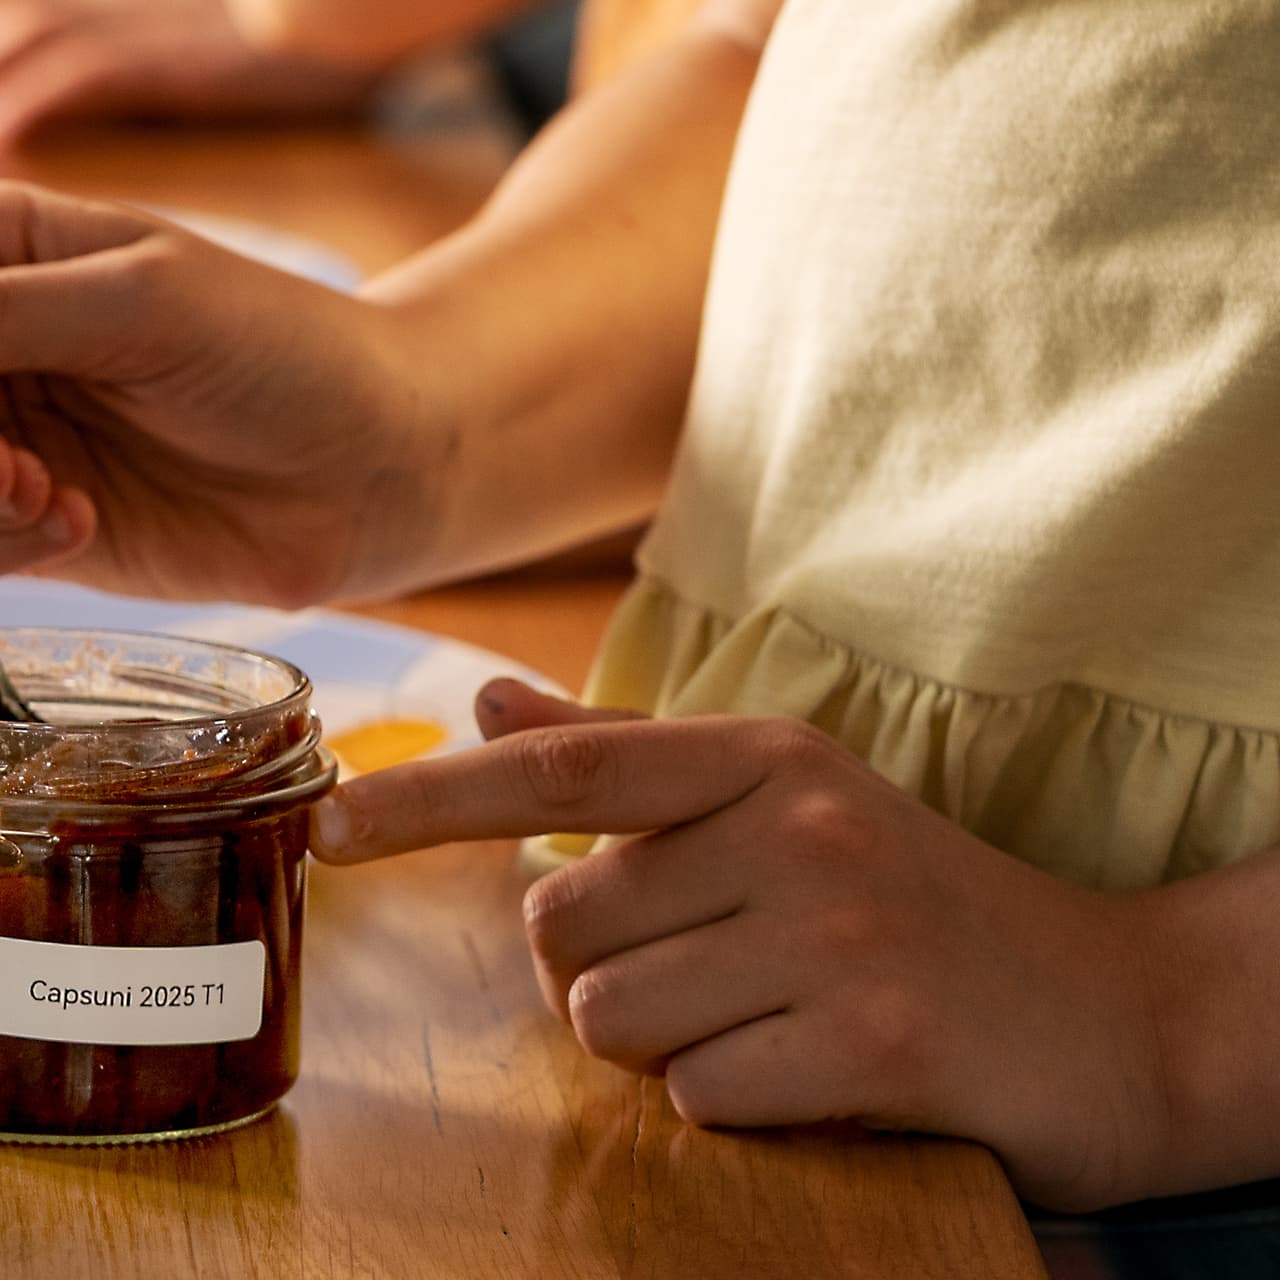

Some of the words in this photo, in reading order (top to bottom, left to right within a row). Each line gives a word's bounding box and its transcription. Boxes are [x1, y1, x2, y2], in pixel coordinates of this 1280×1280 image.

[30, 980, 131, 1010] Capsuni
[140, 985, 195, 1007] 2025
[202, 984, 225, 1005] T1
